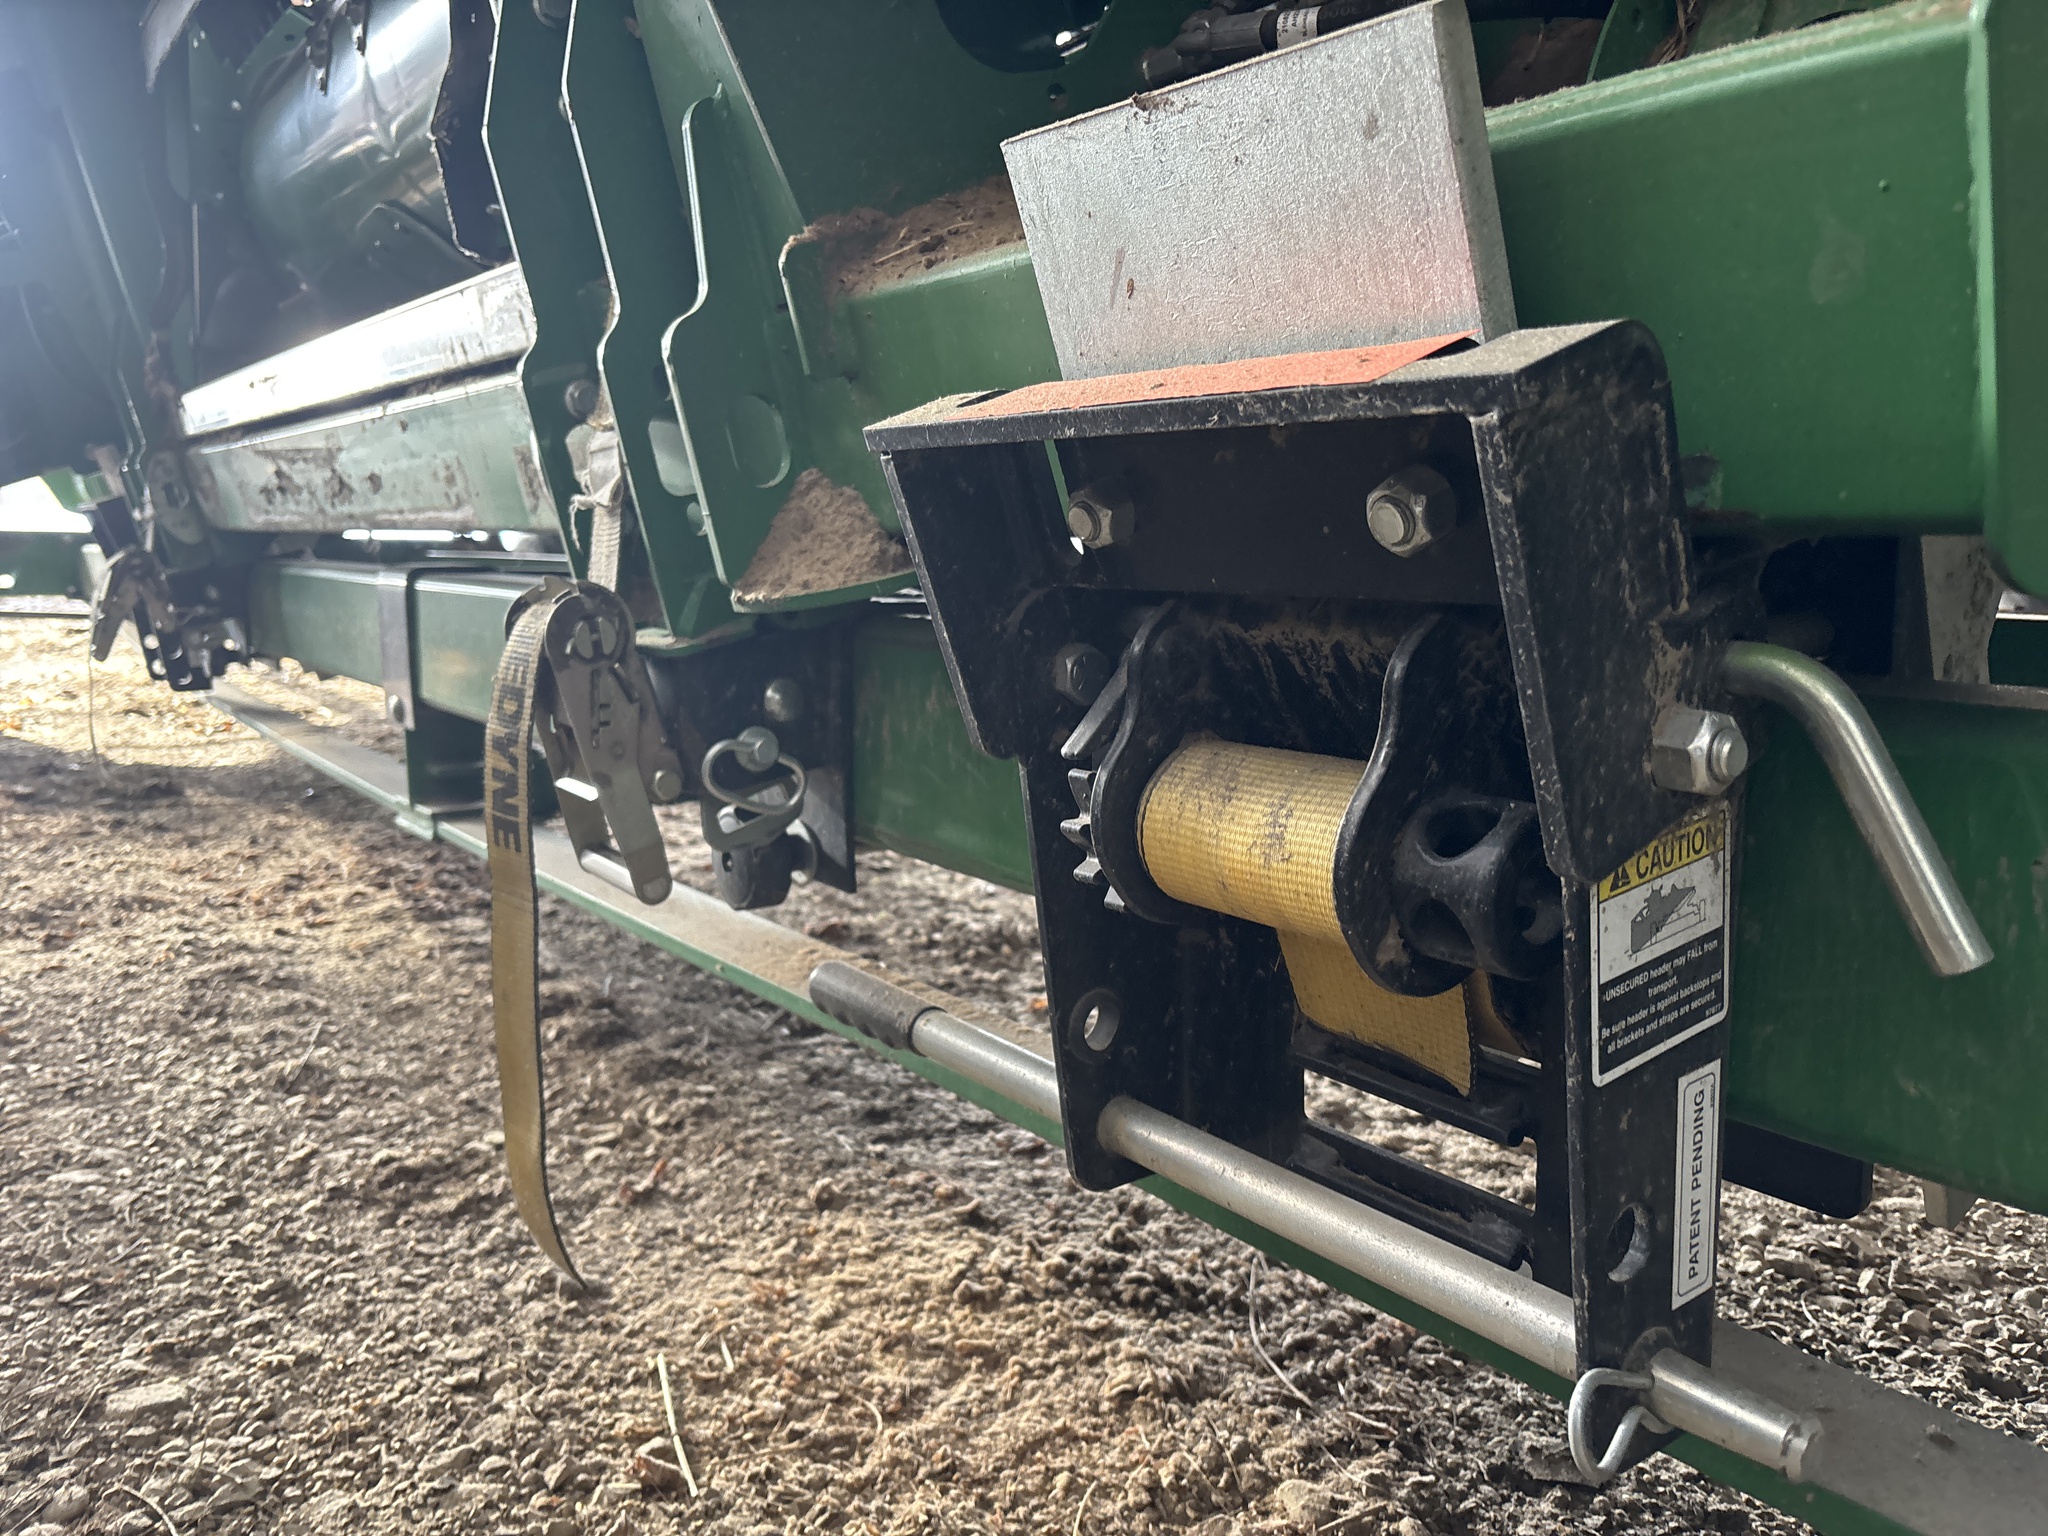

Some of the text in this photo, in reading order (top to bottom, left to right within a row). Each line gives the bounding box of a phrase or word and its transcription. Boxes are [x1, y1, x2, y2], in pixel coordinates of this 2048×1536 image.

[1636, 823, 1719, 879] CAUTION
[1605, 939, 1718, 1001] UNSECURED header may FALL from
[1648, 975, 1679, 998] transport.
[1601, 969, 1722, 1039] Be sure header is against backstops and
[1607, 990, 1717, 1054] all brackets and straps are secured.
[1688, 1088, 1705, 1281] PATENT PENDING
